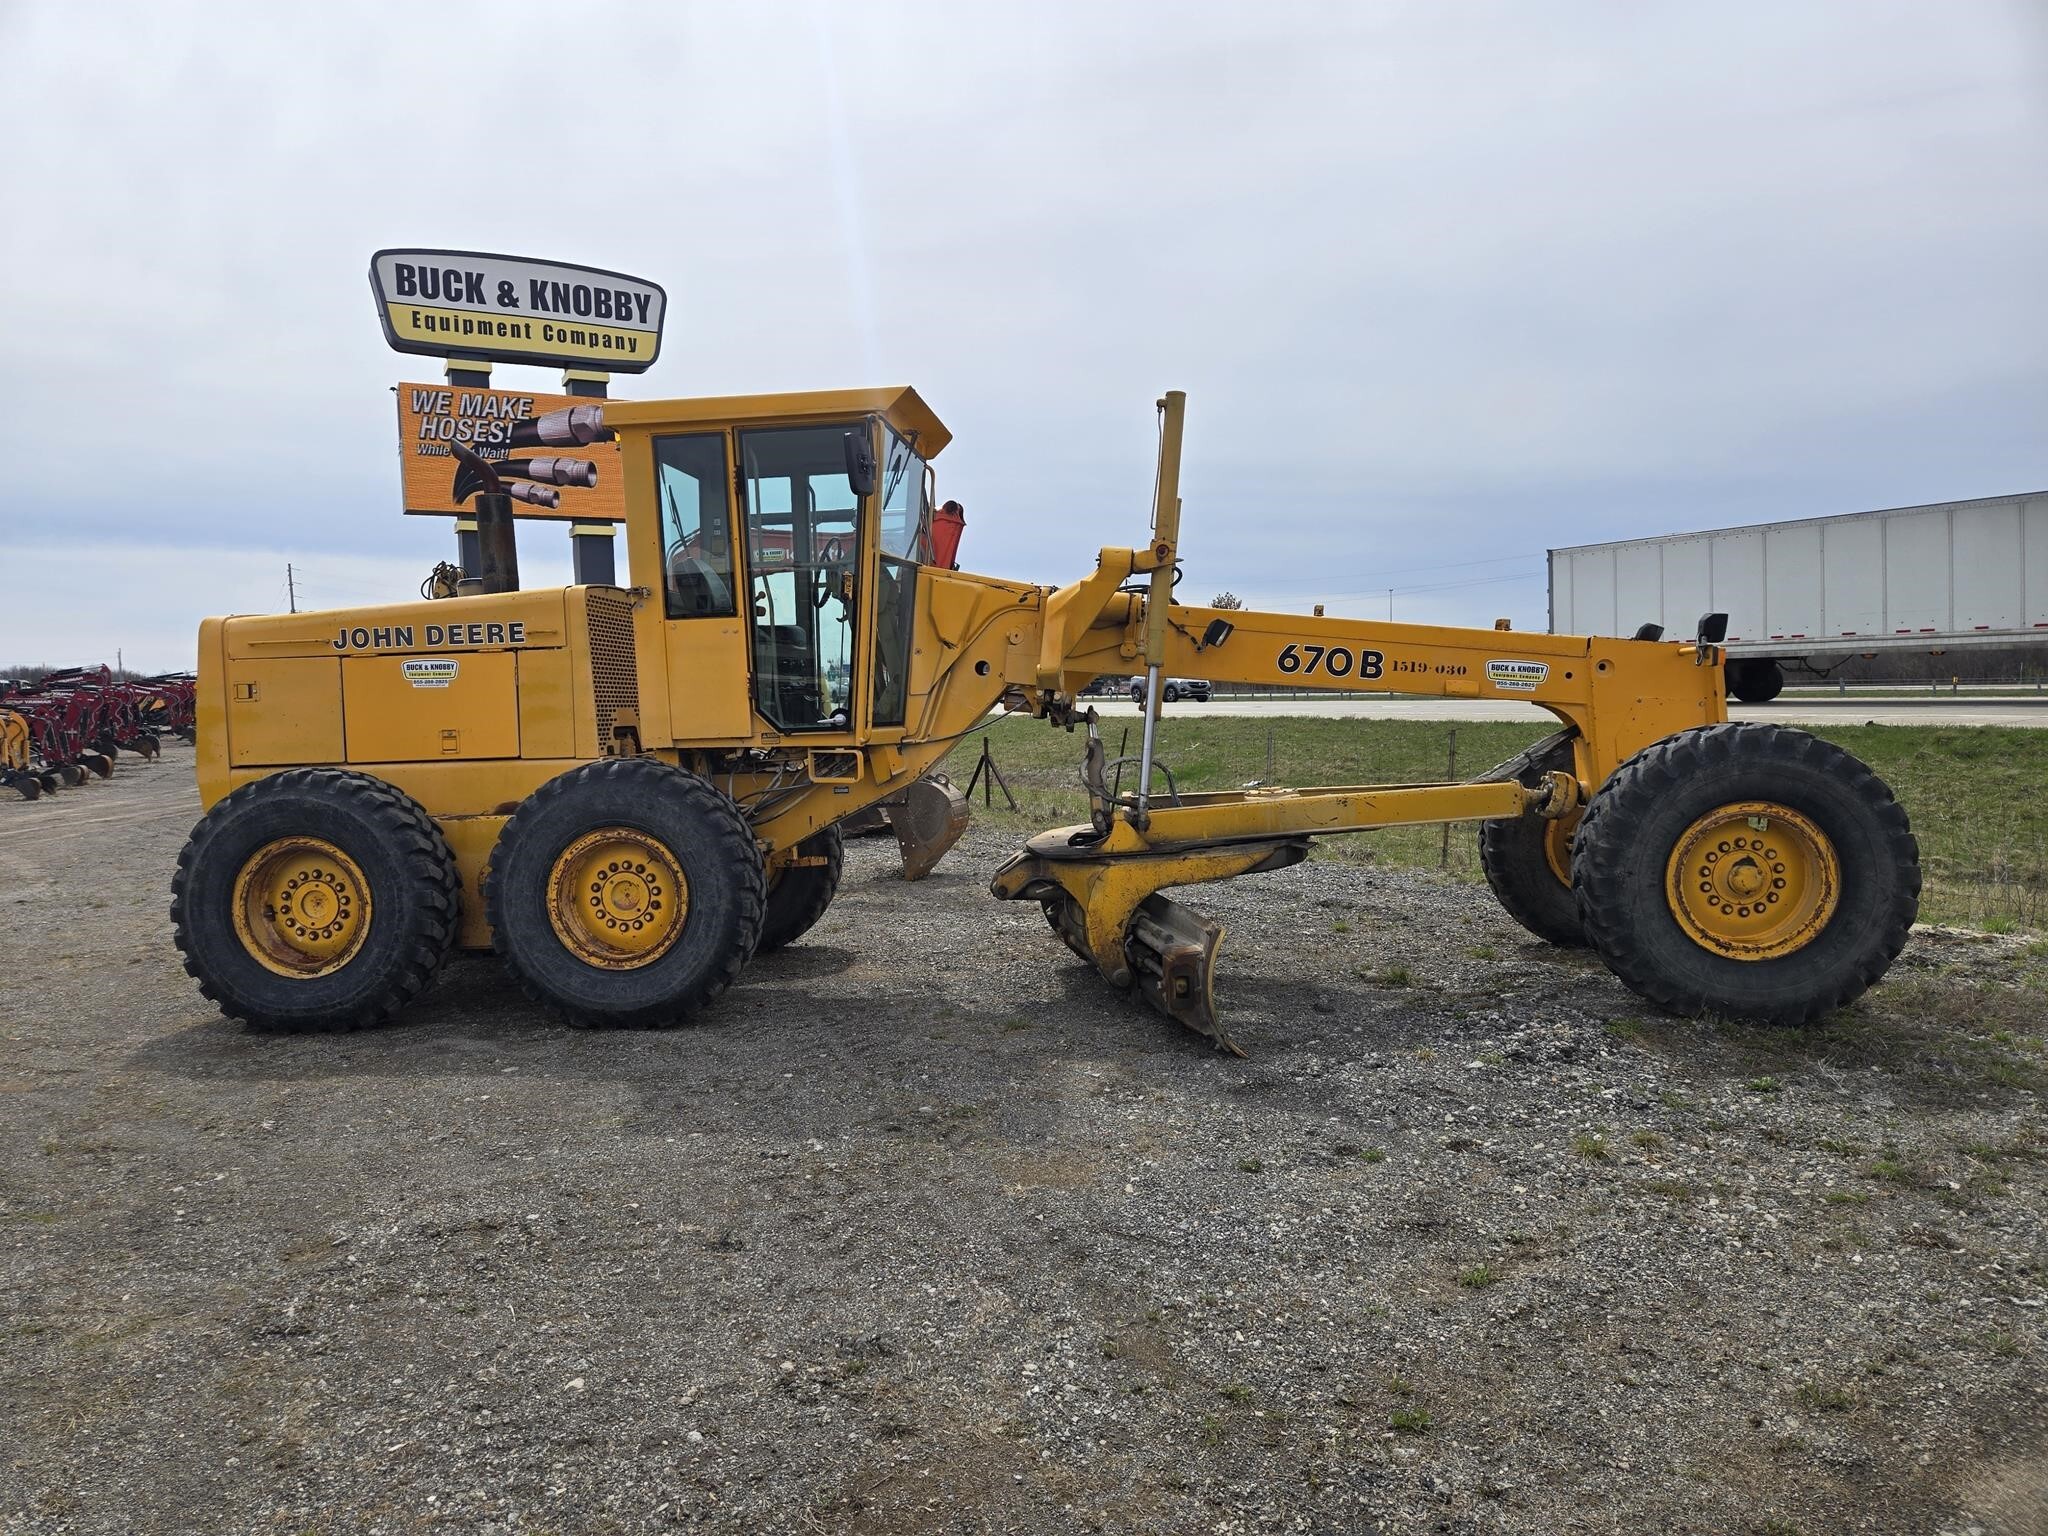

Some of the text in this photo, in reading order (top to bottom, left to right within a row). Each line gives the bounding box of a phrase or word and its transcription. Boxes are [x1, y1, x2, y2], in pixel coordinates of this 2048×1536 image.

[394, 262, 652, 324] BUCK & KNOBBY
[412, 310, 638, 353] Equipment Company
[412, 389, 535, 420] WE MAKE
[419, 415, 514, 444] HOSES!
[417, 443, 451, 457] While
[479, 447, 509, 459] Wait!
[333, 622, 526, 650] JOHN DEERE
